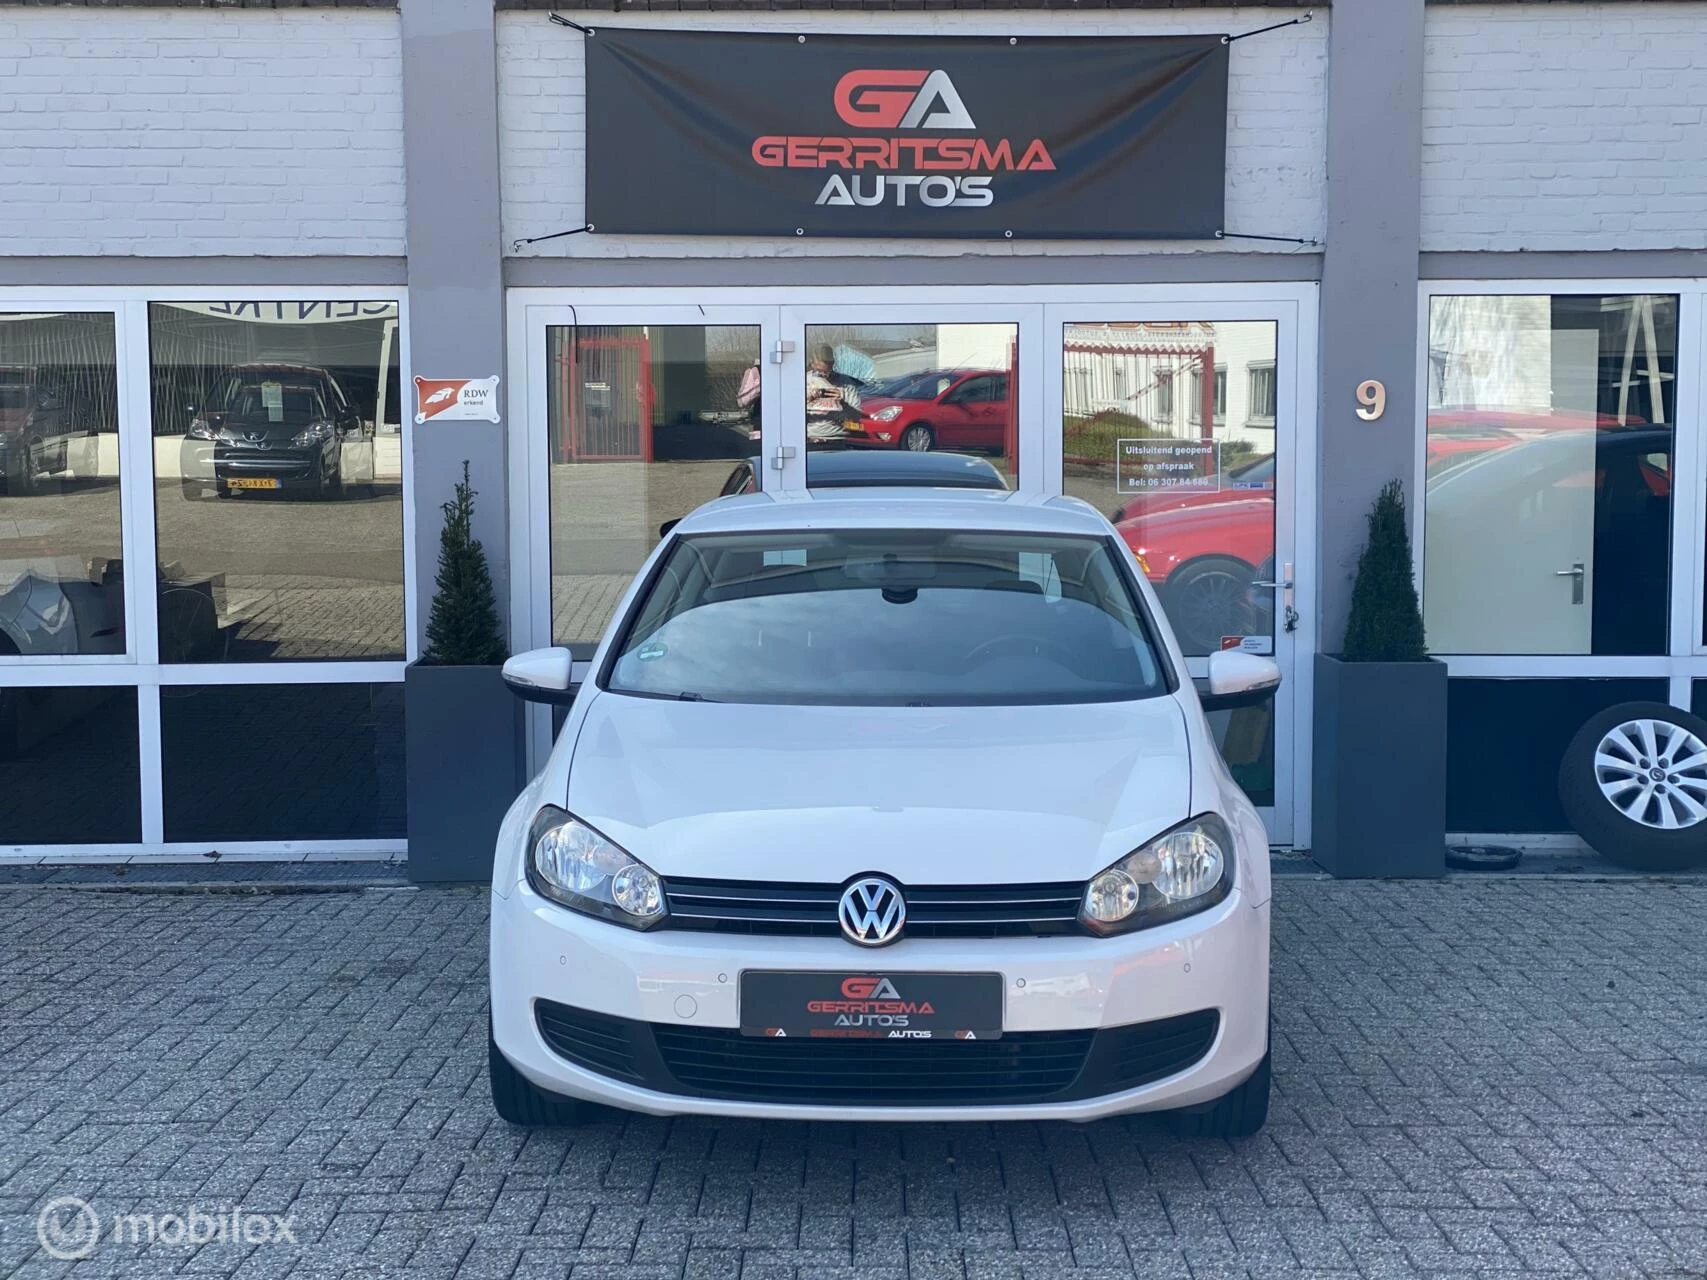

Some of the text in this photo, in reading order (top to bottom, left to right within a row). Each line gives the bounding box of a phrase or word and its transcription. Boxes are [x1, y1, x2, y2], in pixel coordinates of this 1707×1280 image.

[834, 69, 977, 129] GA
[751, 135, 1057, 171] GERRITSMA
[814, 174, 994, 207] AUTO'S
[463, 389, 489, 398] RDW
[1355, 379, 1386, 421] 9
[1125, 446, 1213, 457] Uitsluitend geopend
[1156, 462, 1195, 472] afspraak
[1128, 478, 1146, 487] Bel:
[1147, 478, 1159, 487] 06
[840, 977, 900, 999] GA
[807, 1001, 935, 1014] GERRITSMA
[834, 1014, 909, 1027] AUTO'S
